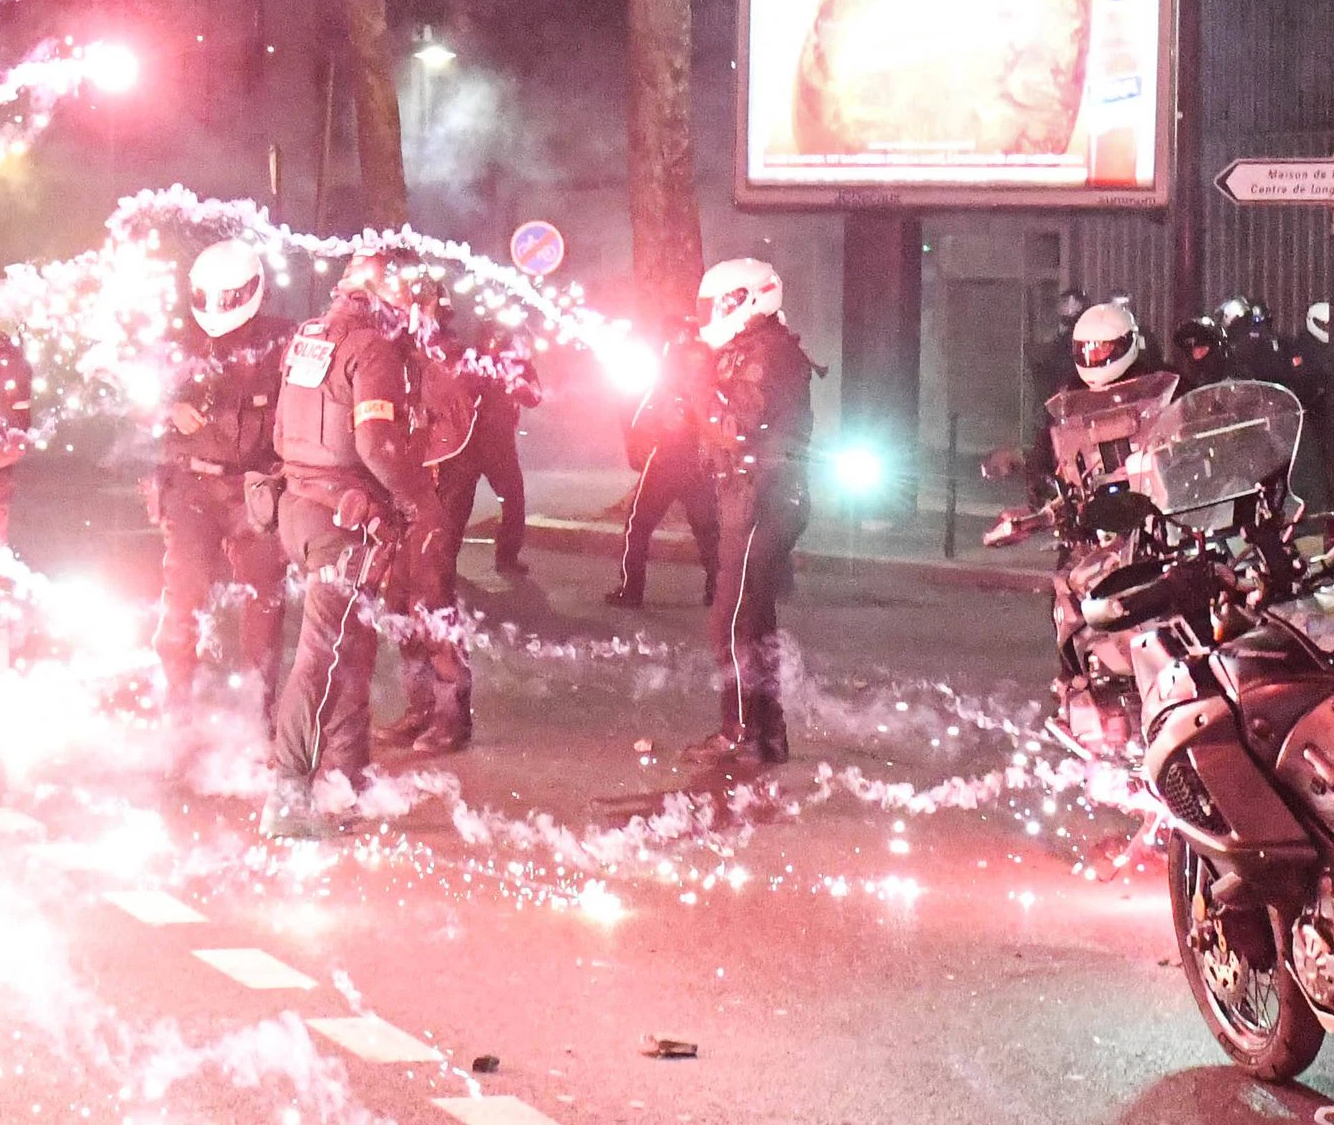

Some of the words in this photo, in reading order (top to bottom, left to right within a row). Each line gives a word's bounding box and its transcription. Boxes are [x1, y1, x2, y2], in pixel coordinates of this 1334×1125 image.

[1268, 169, 1308, 179] Maison
[1313, 169, 1327, 179] de
[1250, 183, 1287, 194] Centre
[1292, 183, 1306, 194] de
